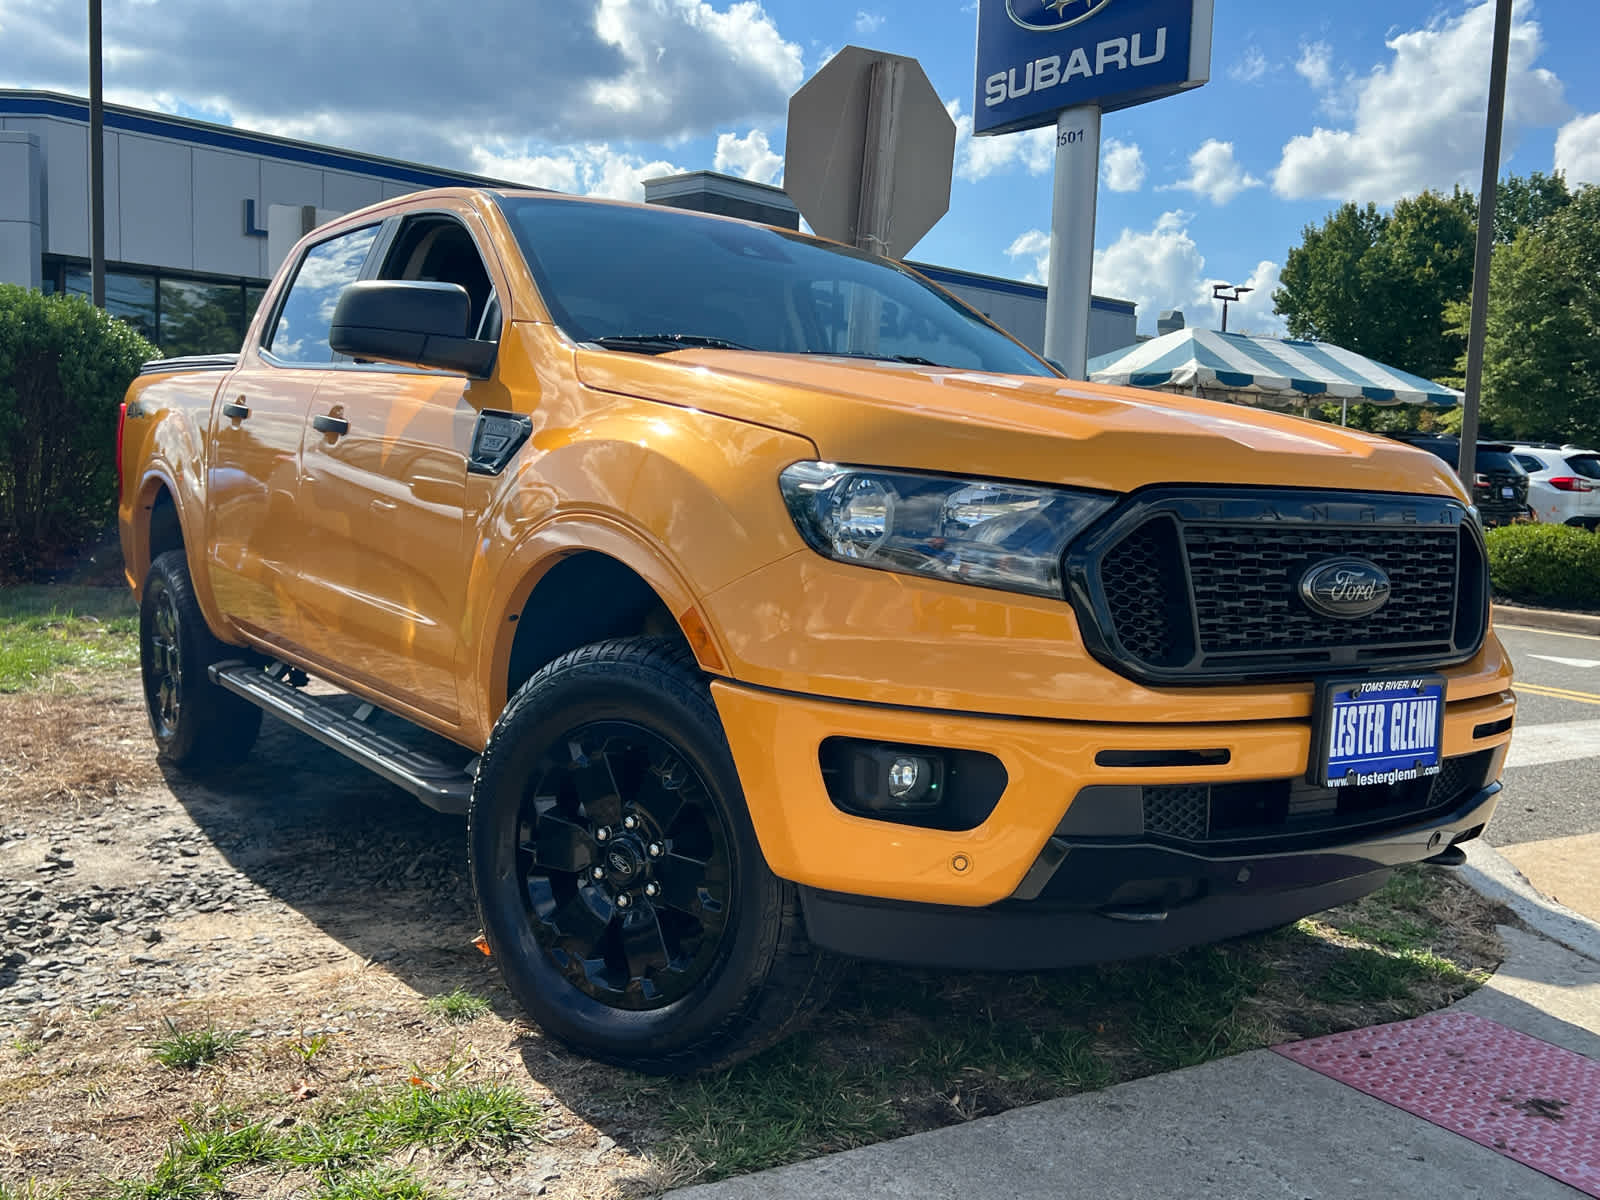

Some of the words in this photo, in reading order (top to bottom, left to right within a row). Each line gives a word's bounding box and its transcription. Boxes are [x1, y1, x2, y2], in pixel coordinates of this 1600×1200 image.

[984, 27, 1167, 107] SUBARU
[1331, 570, 1377, 601] Ford
[1360, 681, 1385, 693] TOMS
[1410, 679, 1423, 689] NJ
[1328, 703, 1385, 758] LESTER
[1390, 700, 1437, 752] GLENN
